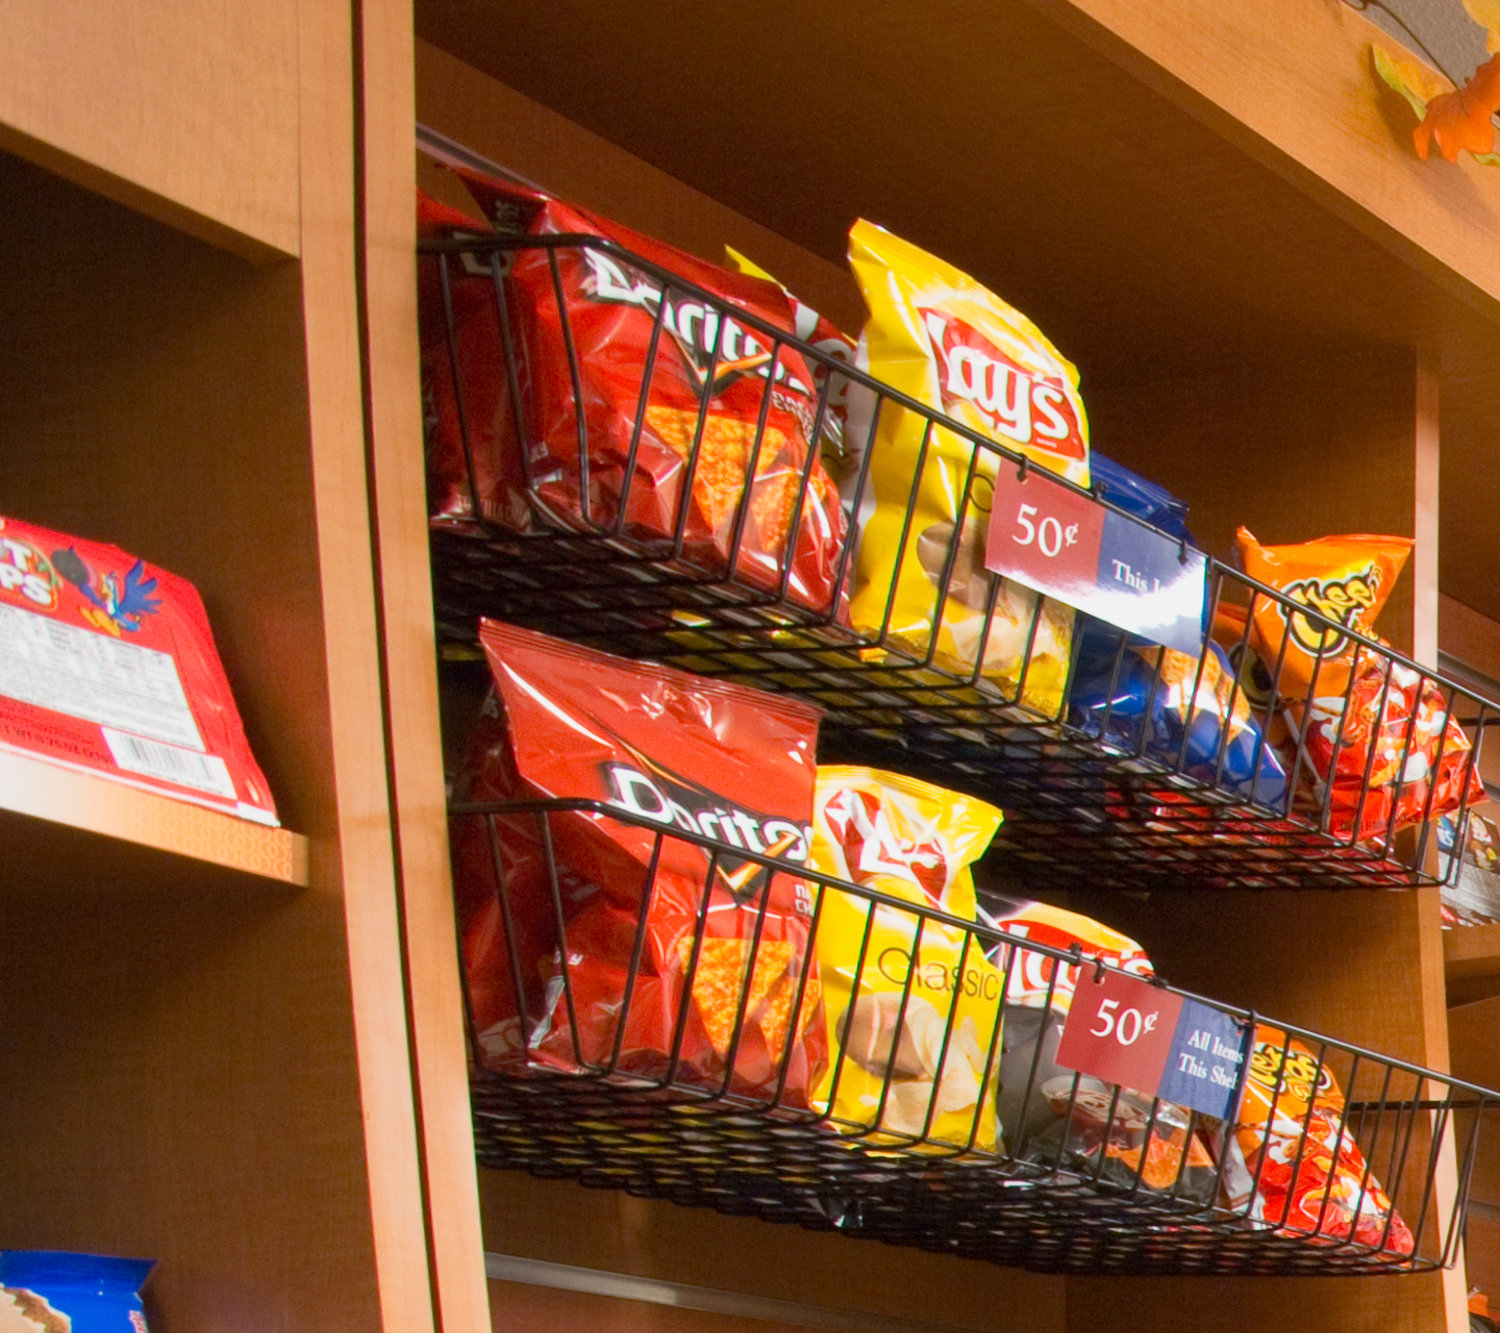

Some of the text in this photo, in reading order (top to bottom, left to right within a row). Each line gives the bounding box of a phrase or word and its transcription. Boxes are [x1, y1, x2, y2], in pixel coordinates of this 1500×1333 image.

[1012, 503, 1079, 558] 50¢
[1090, 998, 1159, 1046] 50¢
[1179, 1053, 1207, 1080] This
[1188, 1028, 1245, 1064] All Items
